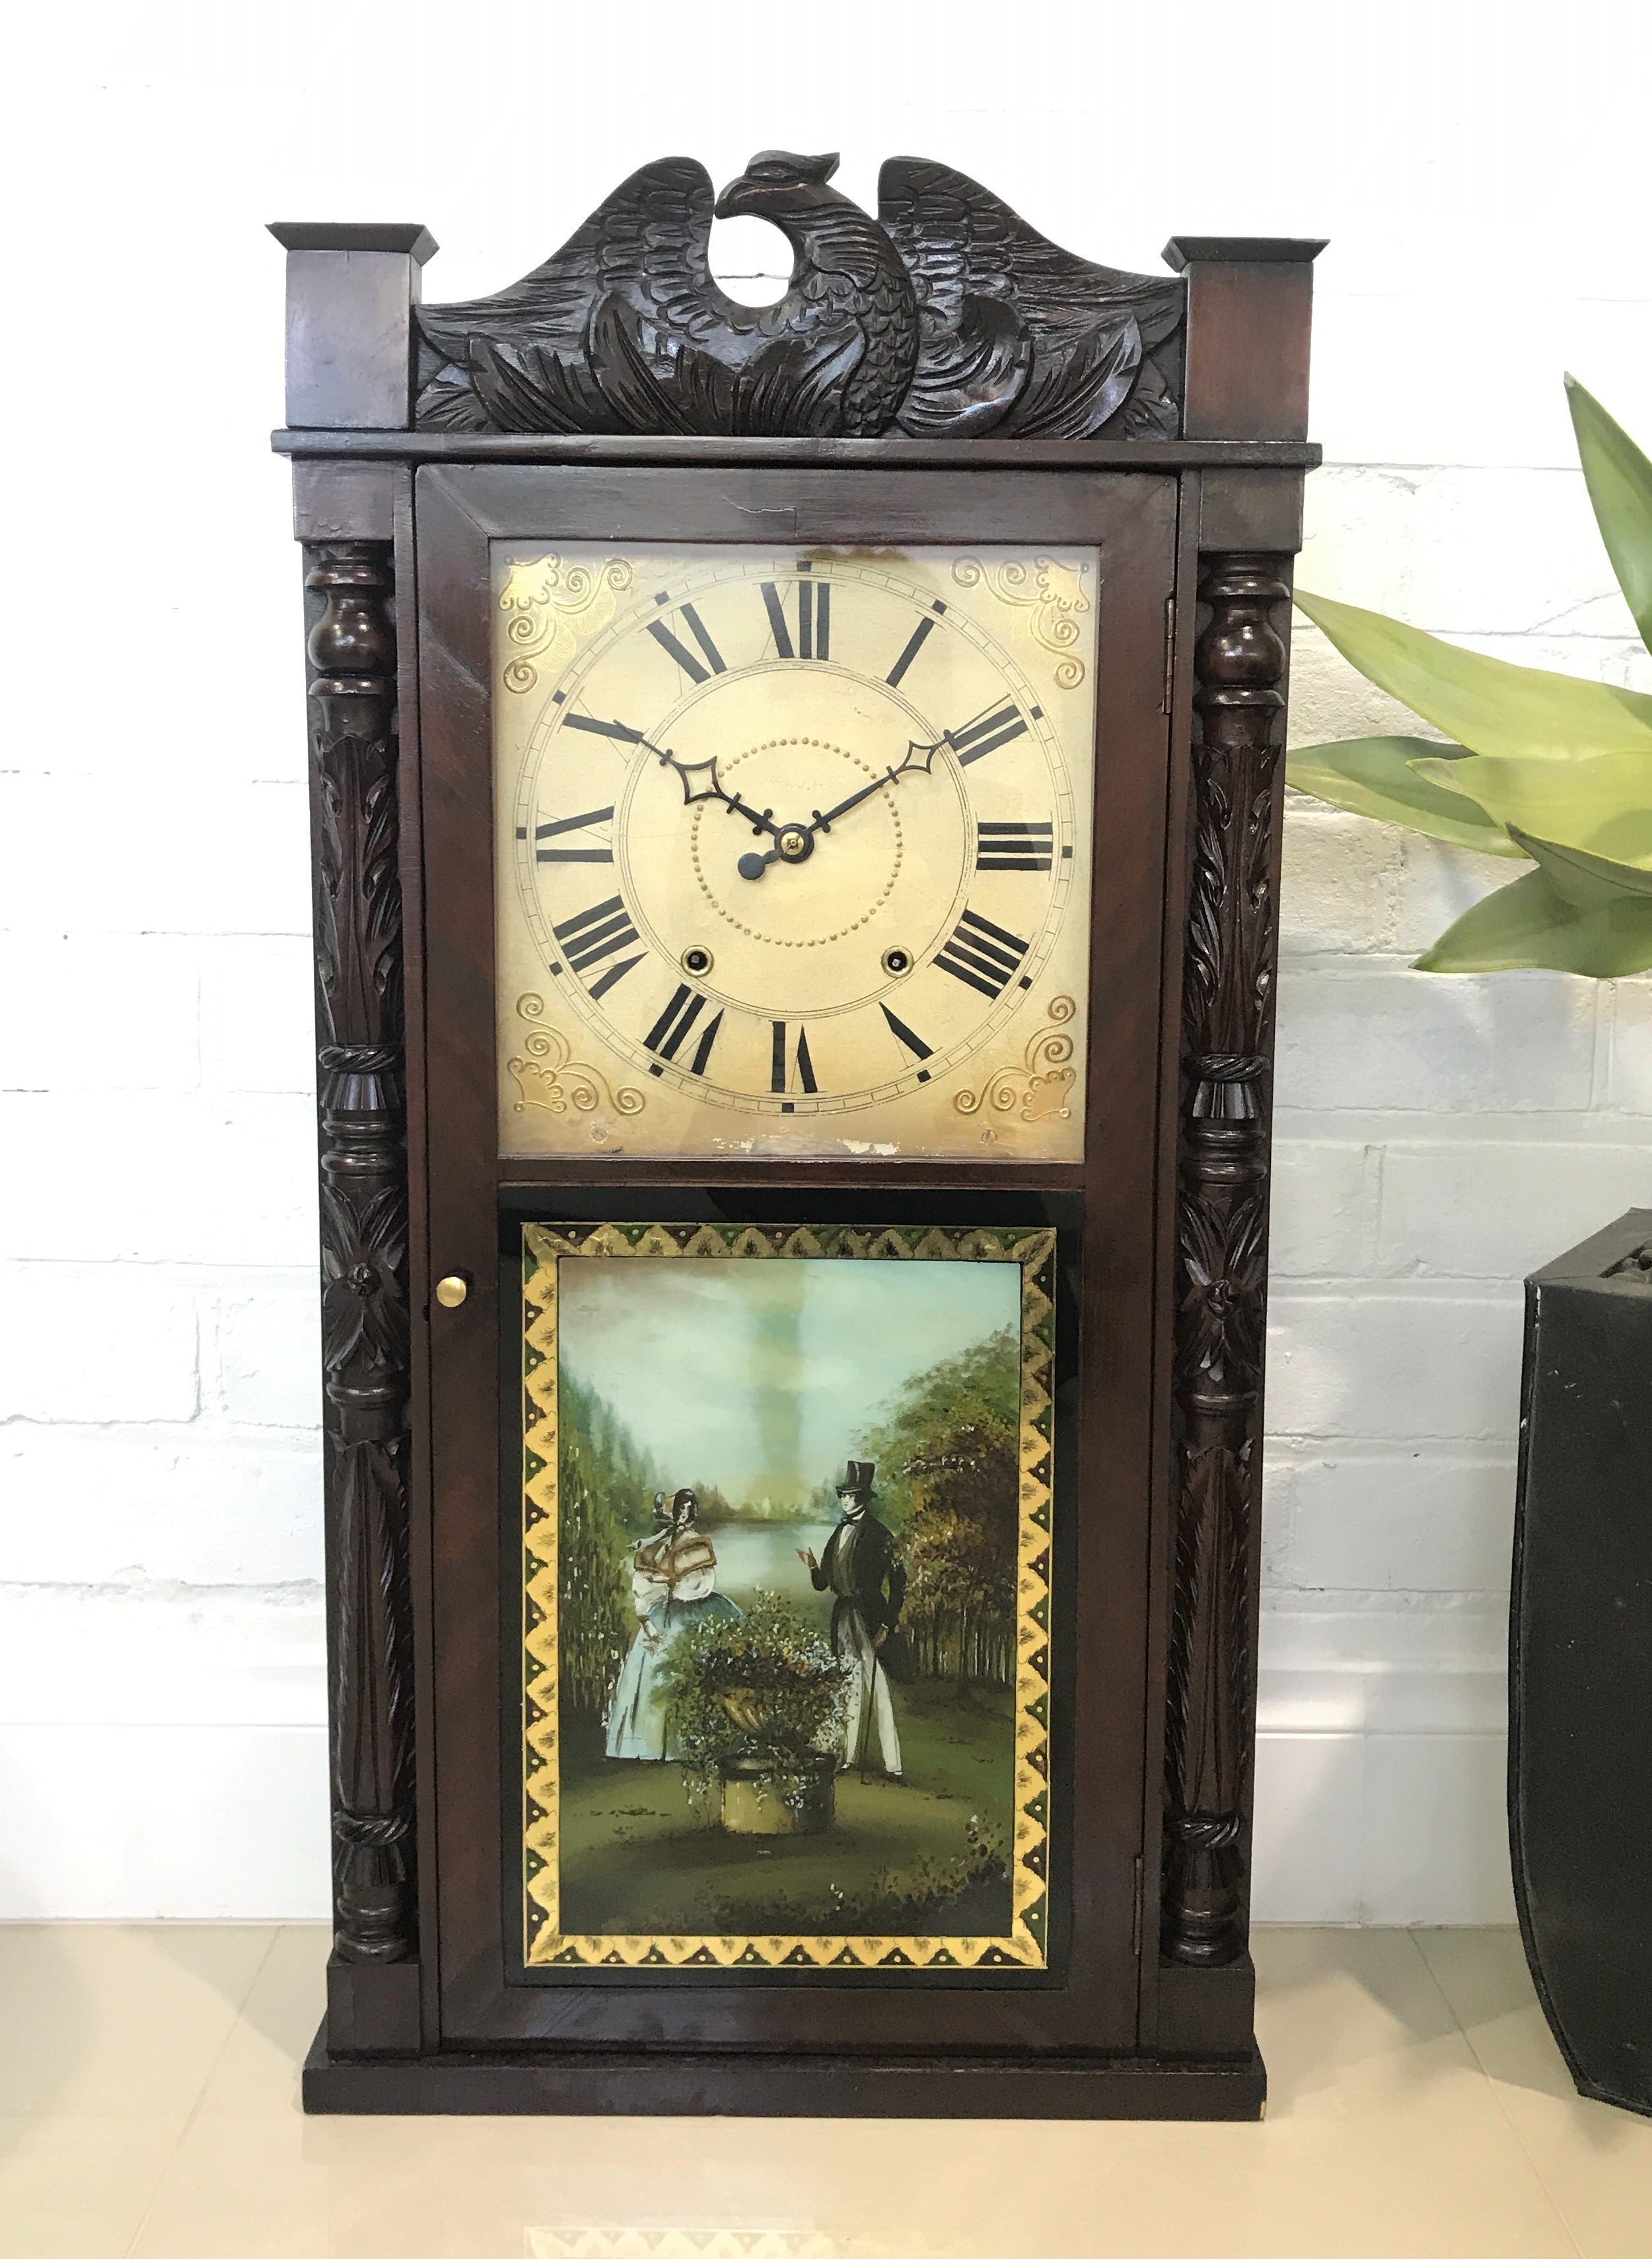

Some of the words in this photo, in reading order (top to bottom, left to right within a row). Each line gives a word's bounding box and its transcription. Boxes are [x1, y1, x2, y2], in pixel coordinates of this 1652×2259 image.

[639, 598, 728, 700] XI
[758, 581, 832, 661] XII
[883, 615, 937, 690] I
[560, 694, 645, 764] X
[950, 703, 1030, 768] II
[536, 805, 616, 863] IX
[976, 821, 1054, 871] III
[552, 895, 651, 1001] VIII
[932, 908, 1030, 1001] IIII
[643, 982, 726, 1076] VII
[878, 1000, 937, 1068] V
